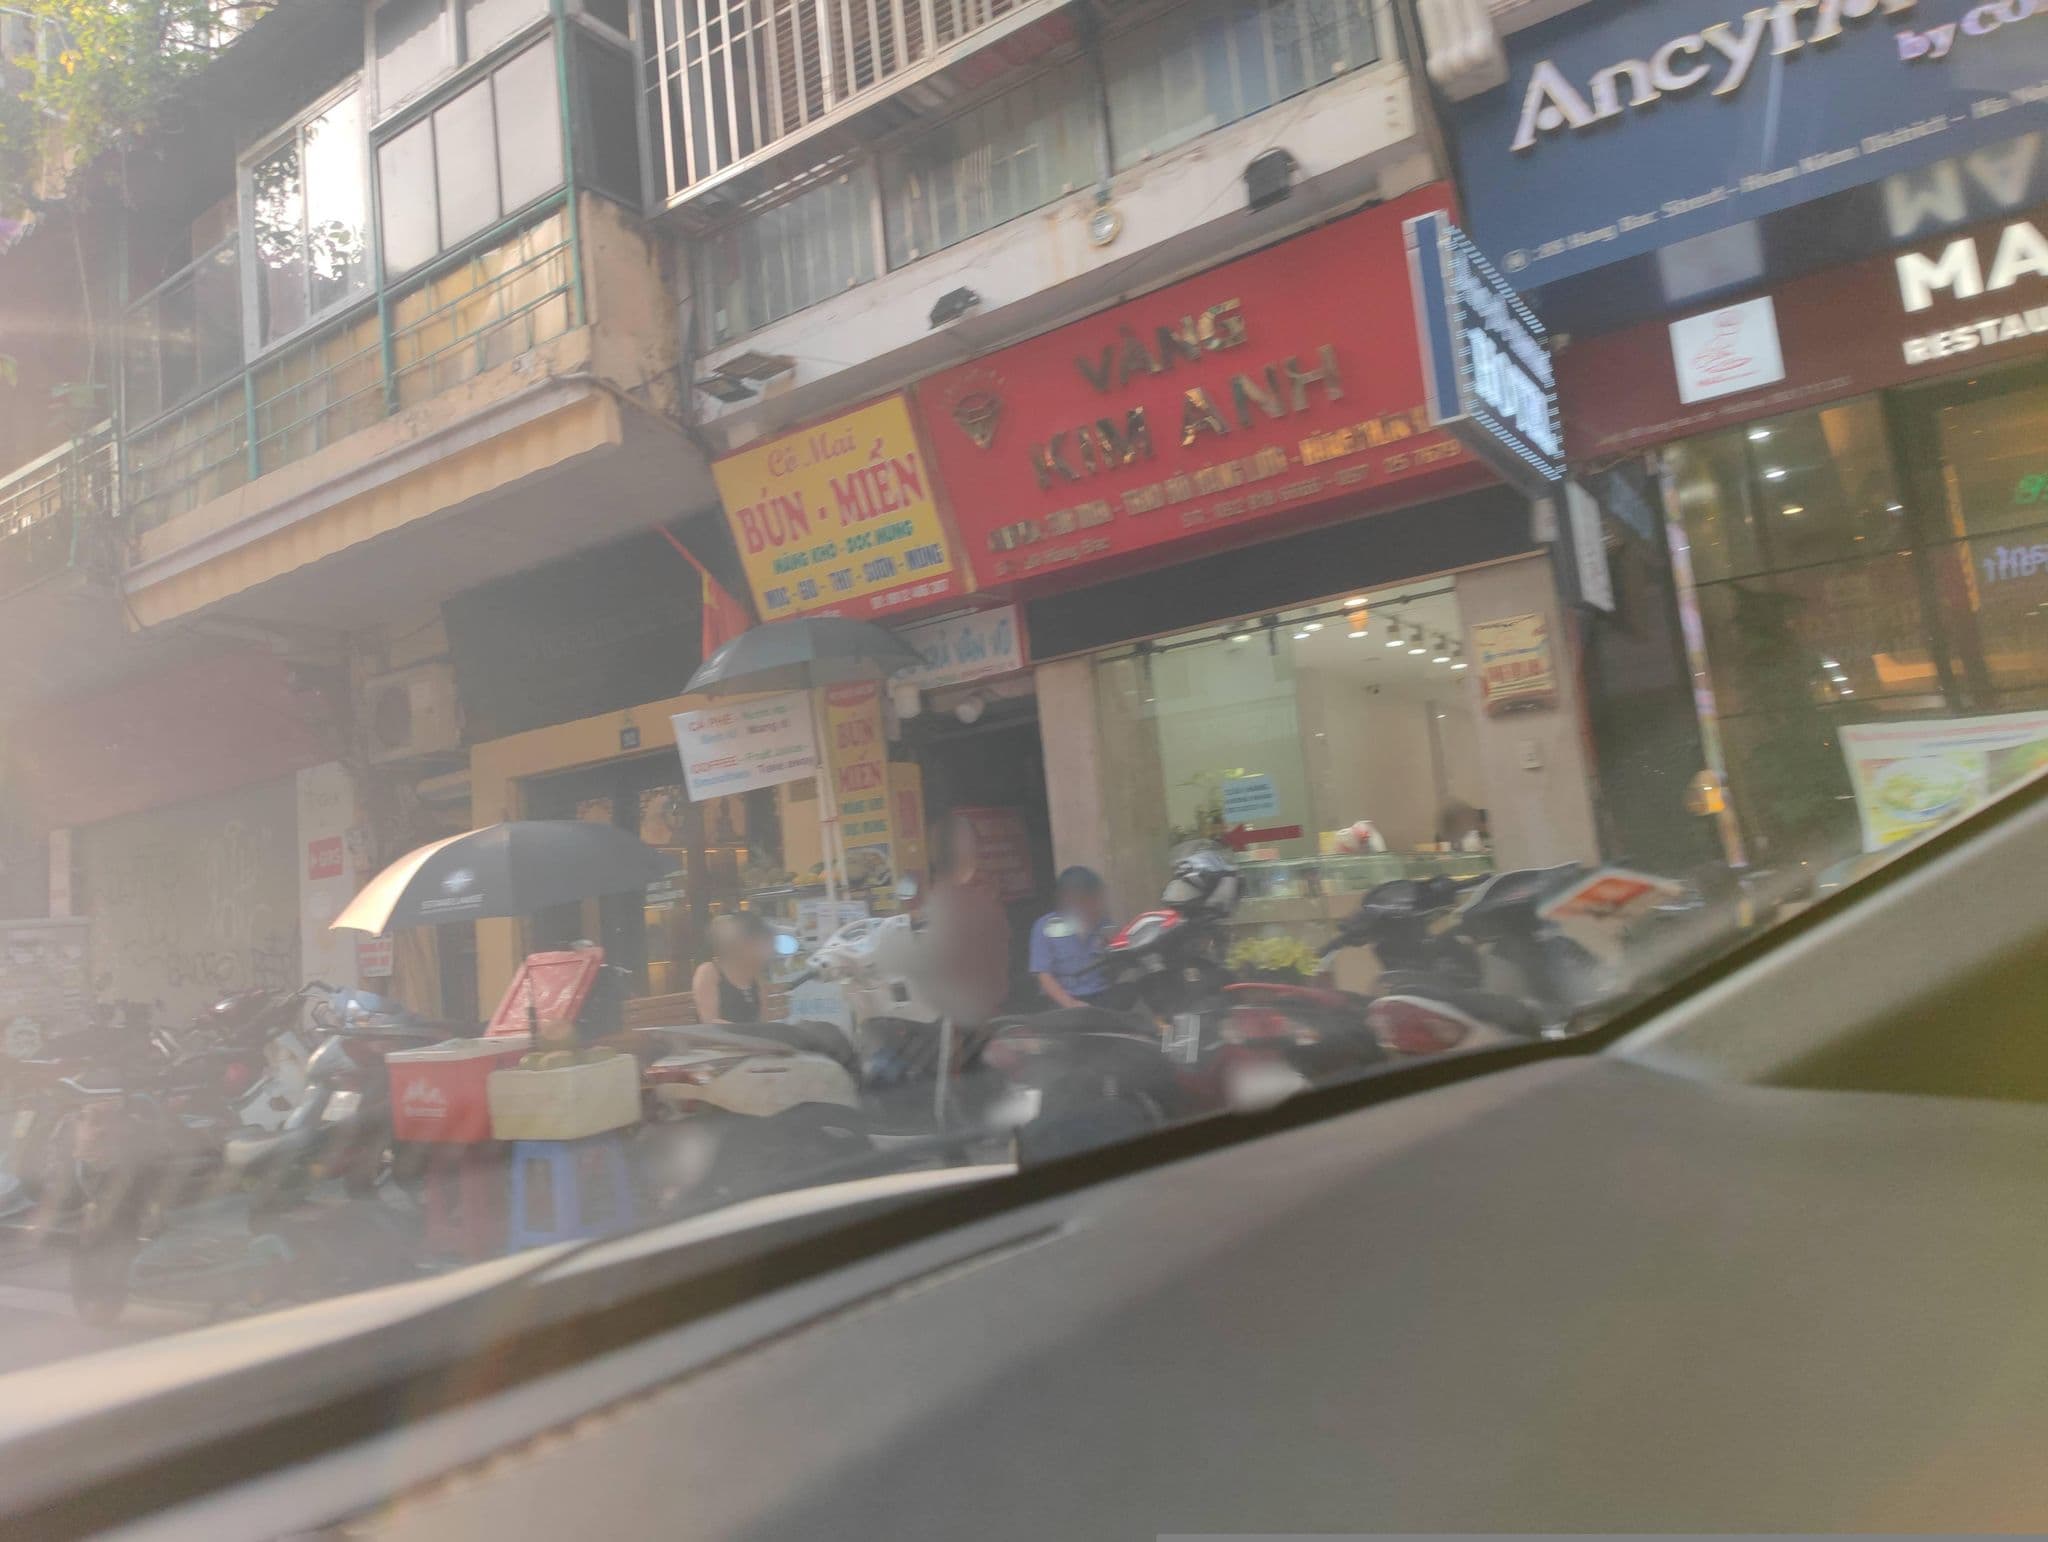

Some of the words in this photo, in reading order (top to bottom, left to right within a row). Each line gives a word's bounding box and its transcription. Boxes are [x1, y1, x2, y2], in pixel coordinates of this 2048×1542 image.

[1896, 23, 1957, 61] by
[1076, 297, 1247, 393] VÀNG
[1028, 404, 1154, 490] KIM
[1180, 343, 1344, 447] ANH
[736, 487, 813, 555] BÚN
